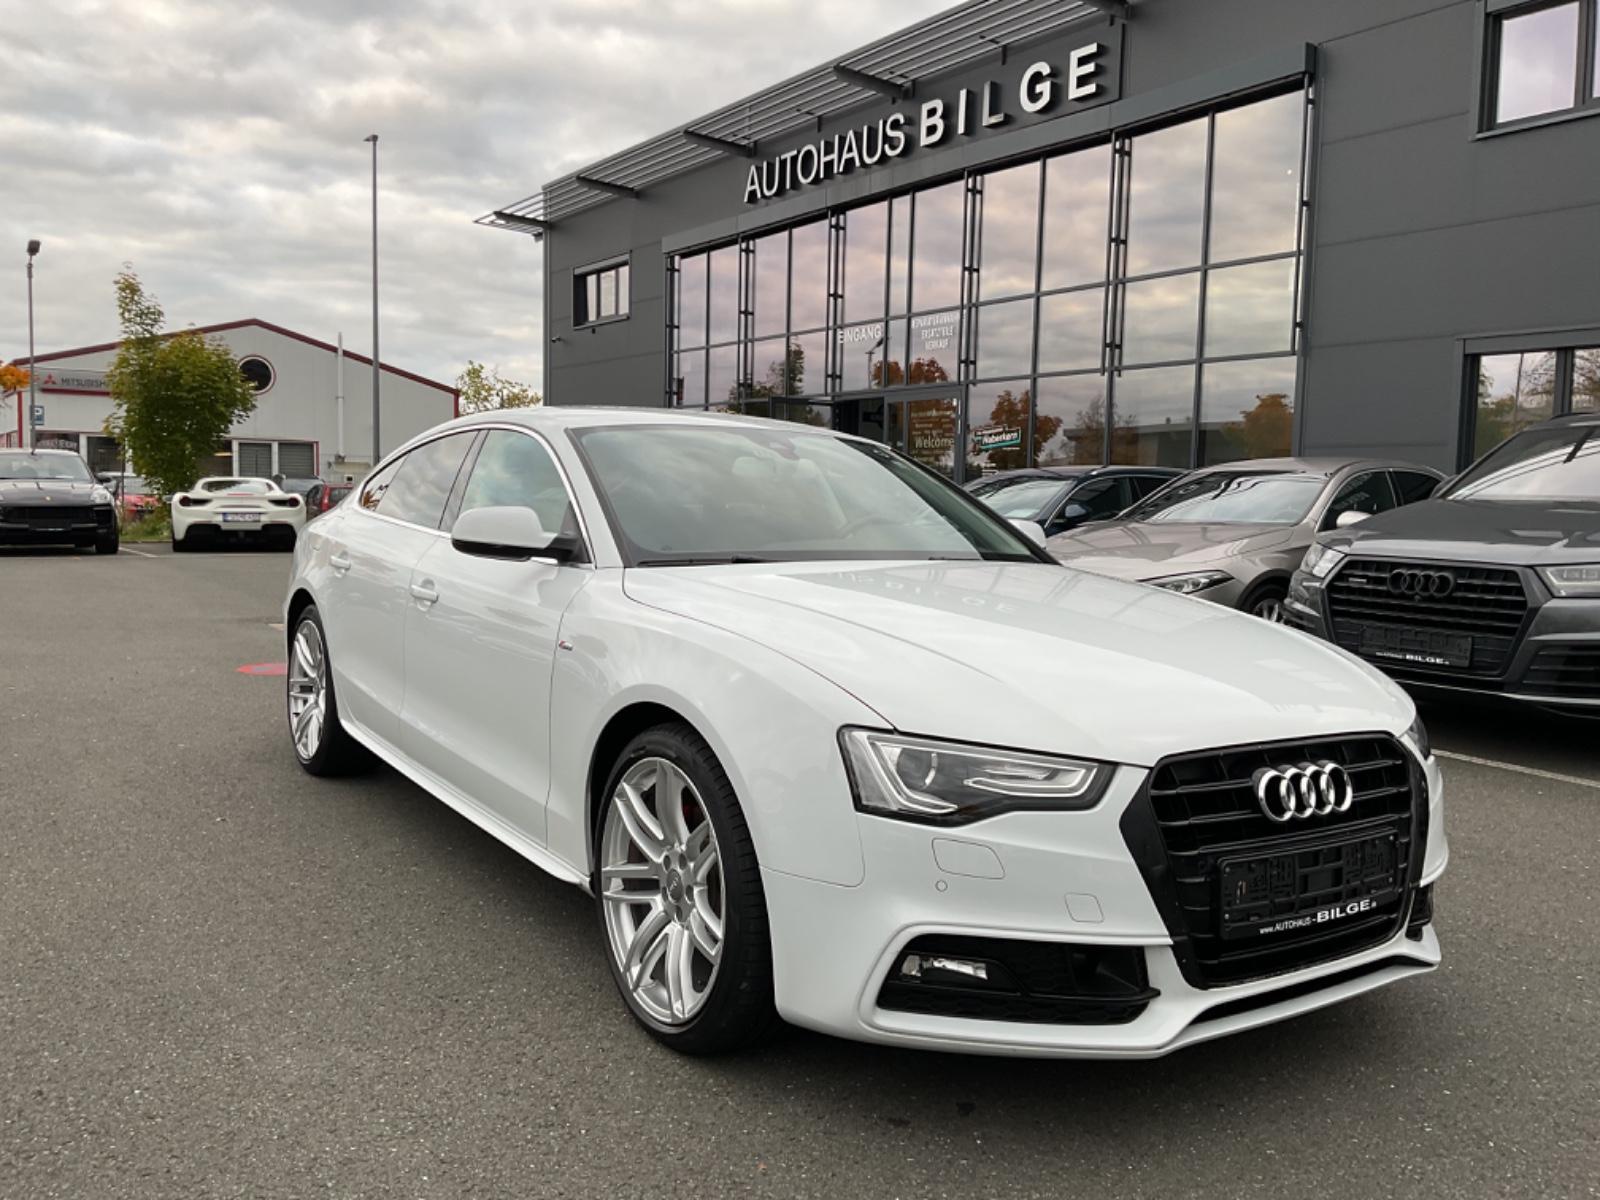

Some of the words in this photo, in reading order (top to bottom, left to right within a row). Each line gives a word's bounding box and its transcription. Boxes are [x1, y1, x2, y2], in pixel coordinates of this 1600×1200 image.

[744, 112, 906, 203] AUTOHAUS
[919, 41, 1099, 148] BILGE
[838, 324, 883, 344] EINGANG
[61, 376, 106, 388] MITSUBISH
[914, 435, 955, 449] Welcome
